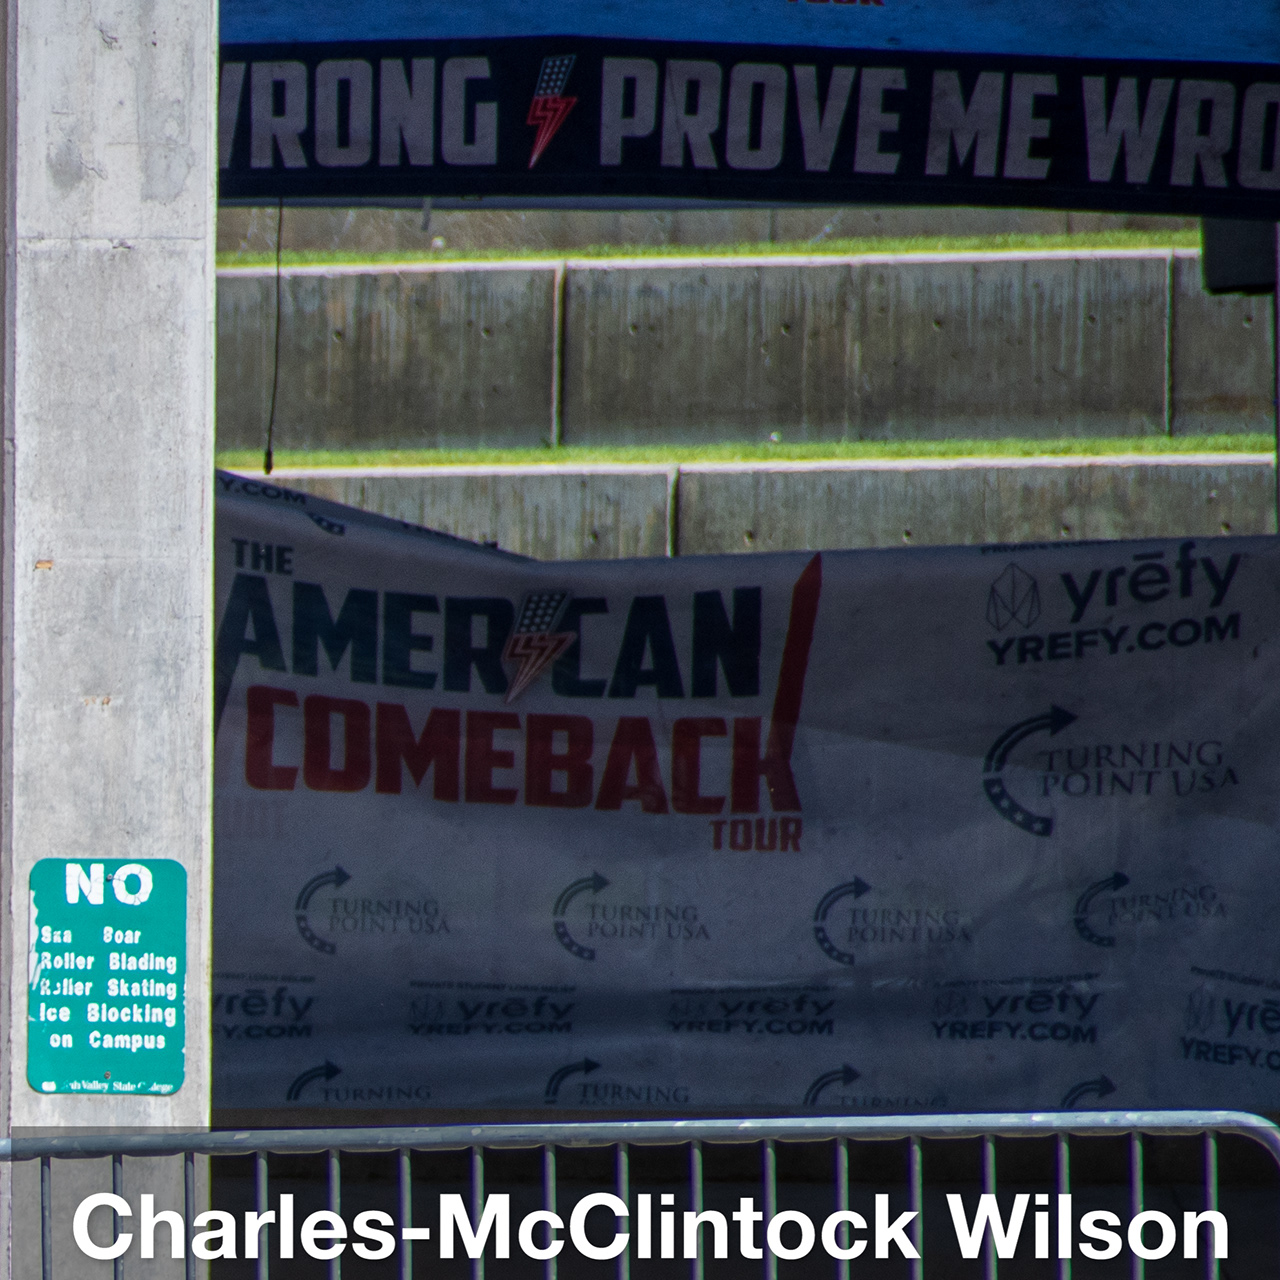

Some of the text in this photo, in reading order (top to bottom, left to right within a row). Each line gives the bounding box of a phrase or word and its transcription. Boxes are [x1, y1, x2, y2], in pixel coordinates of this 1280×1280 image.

[218, 57, 499, 169] RONG
[599, 57, 908, 174] PROVE
[924, 70, 1059, 181] ME
[231, 537, 294, 575] THE
[987, 612, 1242, 666] YREFY.COM
[1041, 740, 1224, 772] TURNING
[1041, 767, 1240, 798] POINT USA
[709, 818, 803, 852] TOUR
[65, 862, 154, 906] NO
[328, 898, 439, 917] TURNING
[585, 902, 698, 922] TURNING
[848, 908, 960, 926] TURNING
[328, 914, 450, 934] POINT USA
[587, 921, 711, 940] POINT USA
[40, 951, 177, 975] Roller Blading
[107, 977, 177, 1001] Skating
[39, 1001, 177, 1027] Ice Blocking
[409, 1021, 572, 1037] YREFY.COM
[667, 1019, 835, 1036] YREFY.COM
[931, 1020, 1098, 1044] YREFY.COM
[50, 1029, 166, 1053] on Campus
[82, 1080, 109, 1093] Valley
[320, 1084, 432, 1102] TURNING
[579, 1082, 690, 1103] TURNING
